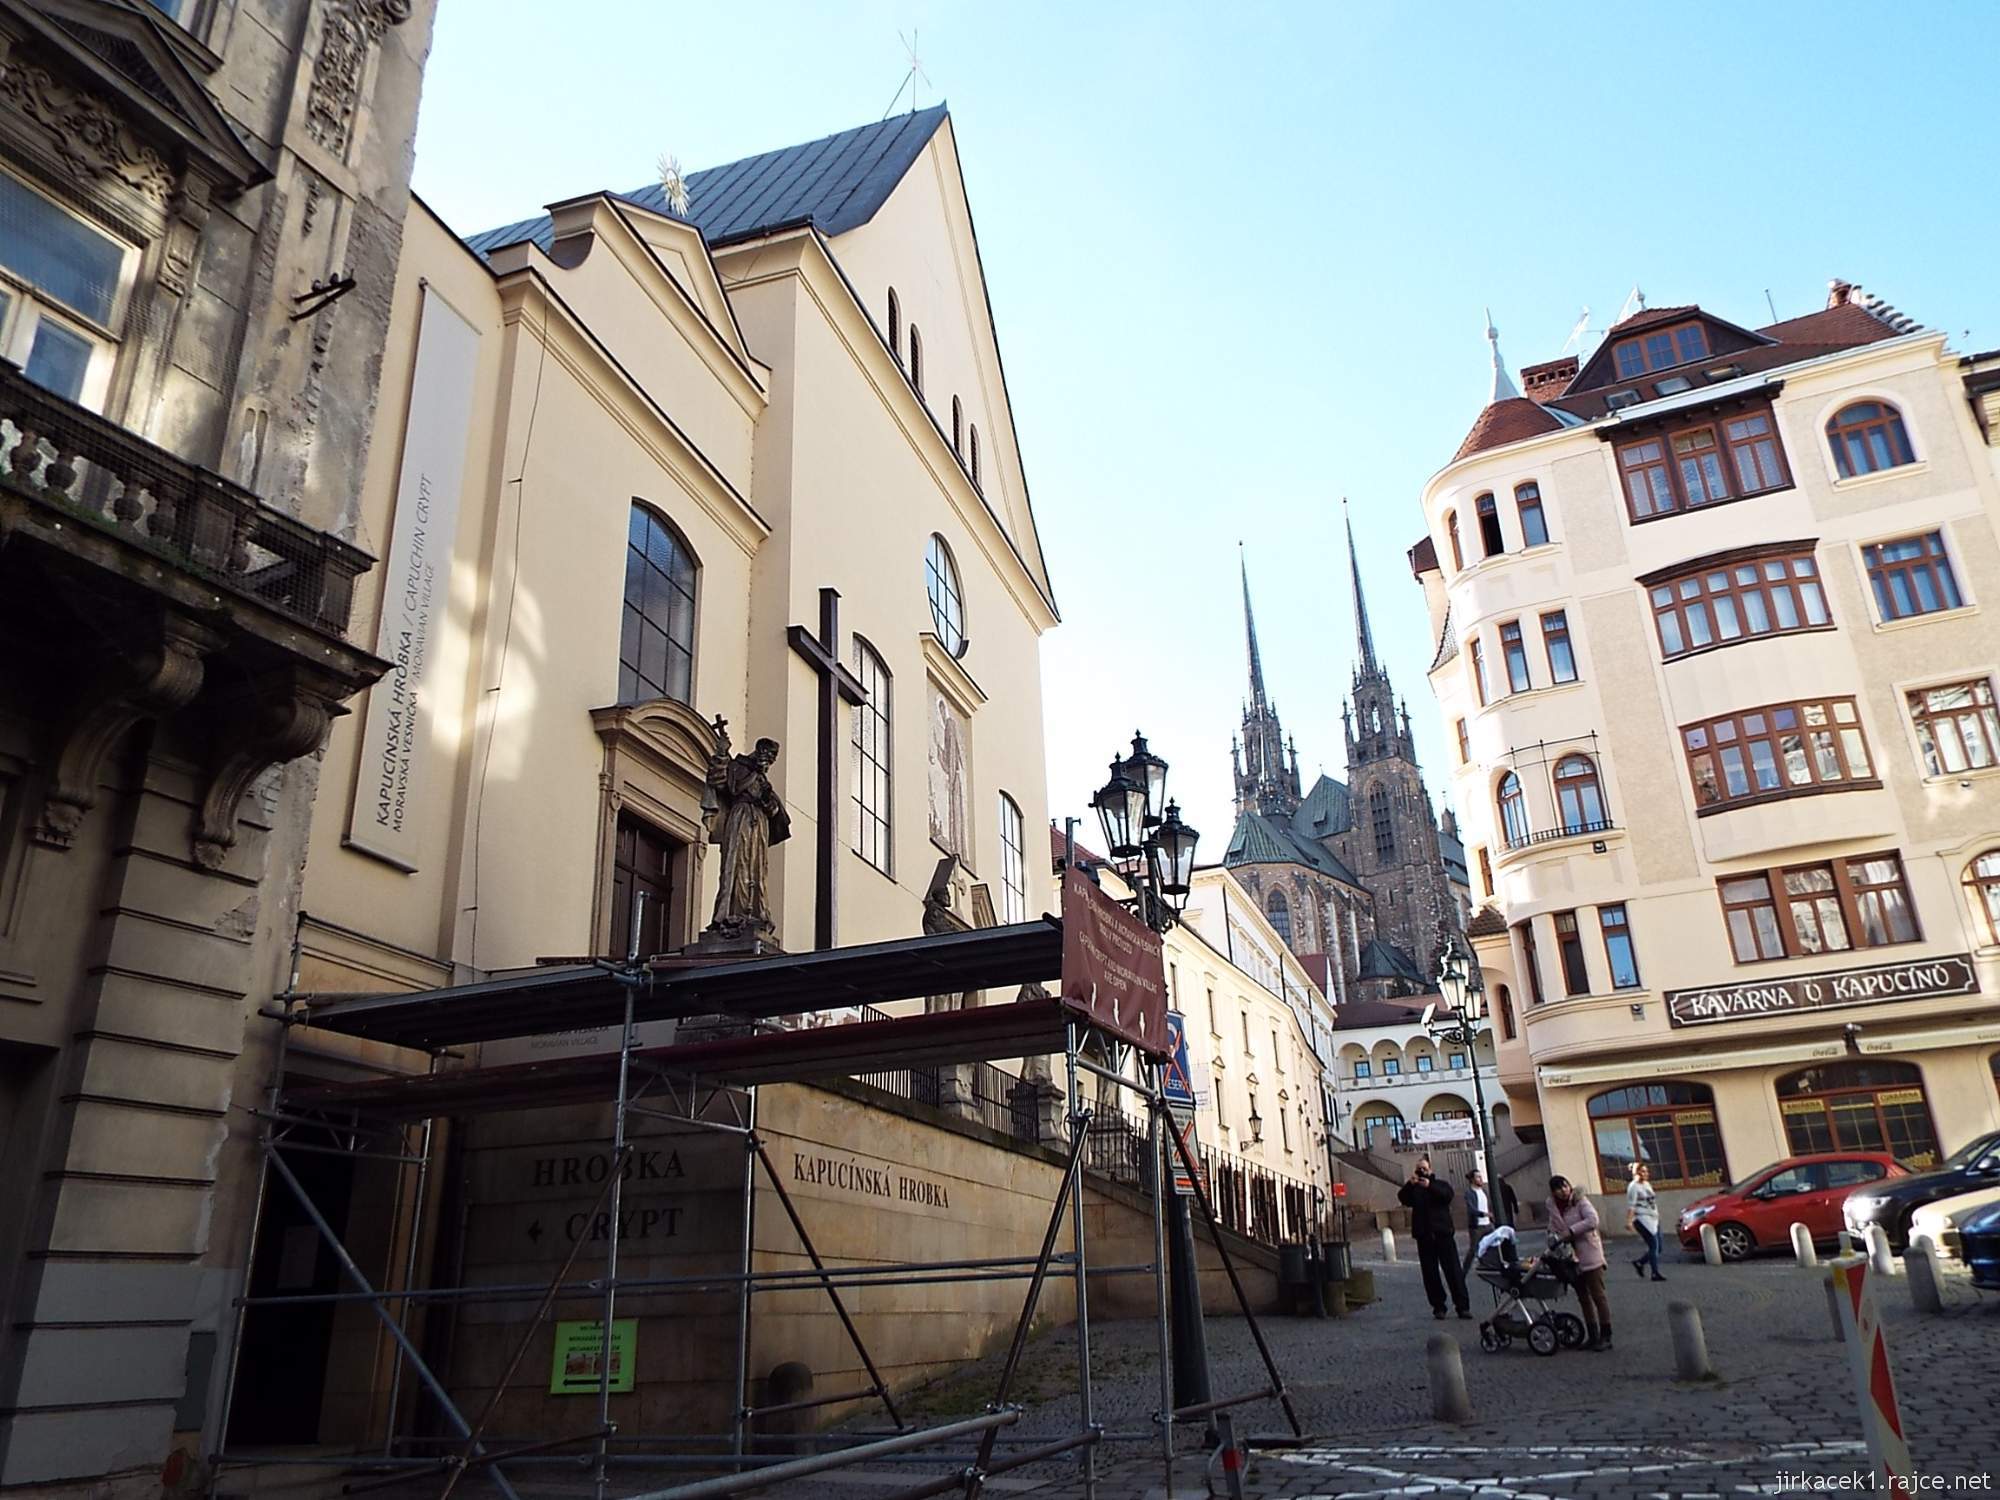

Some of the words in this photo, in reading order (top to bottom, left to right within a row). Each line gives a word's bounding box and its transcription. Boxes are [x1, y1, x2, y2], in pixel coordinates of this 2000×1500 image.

[376, 709, 402, 827] KAPUCÍNSKÁ
[392, 631, 413, 702] HROBKA
[405, 527, 427, 612] CAPUCHIN
[418, 473, 434, 524] CRYPT
[412, 616, 428, 679] MORAVIAN
[420, 564, 435, 613] VILLAGE
[1691, 988, 1794, 1017] KAVÁRNA
[794, 1153, 891, 1198] KAPUCÍNSKÁ
[899, 1175, 950, 1209] HROBKA
